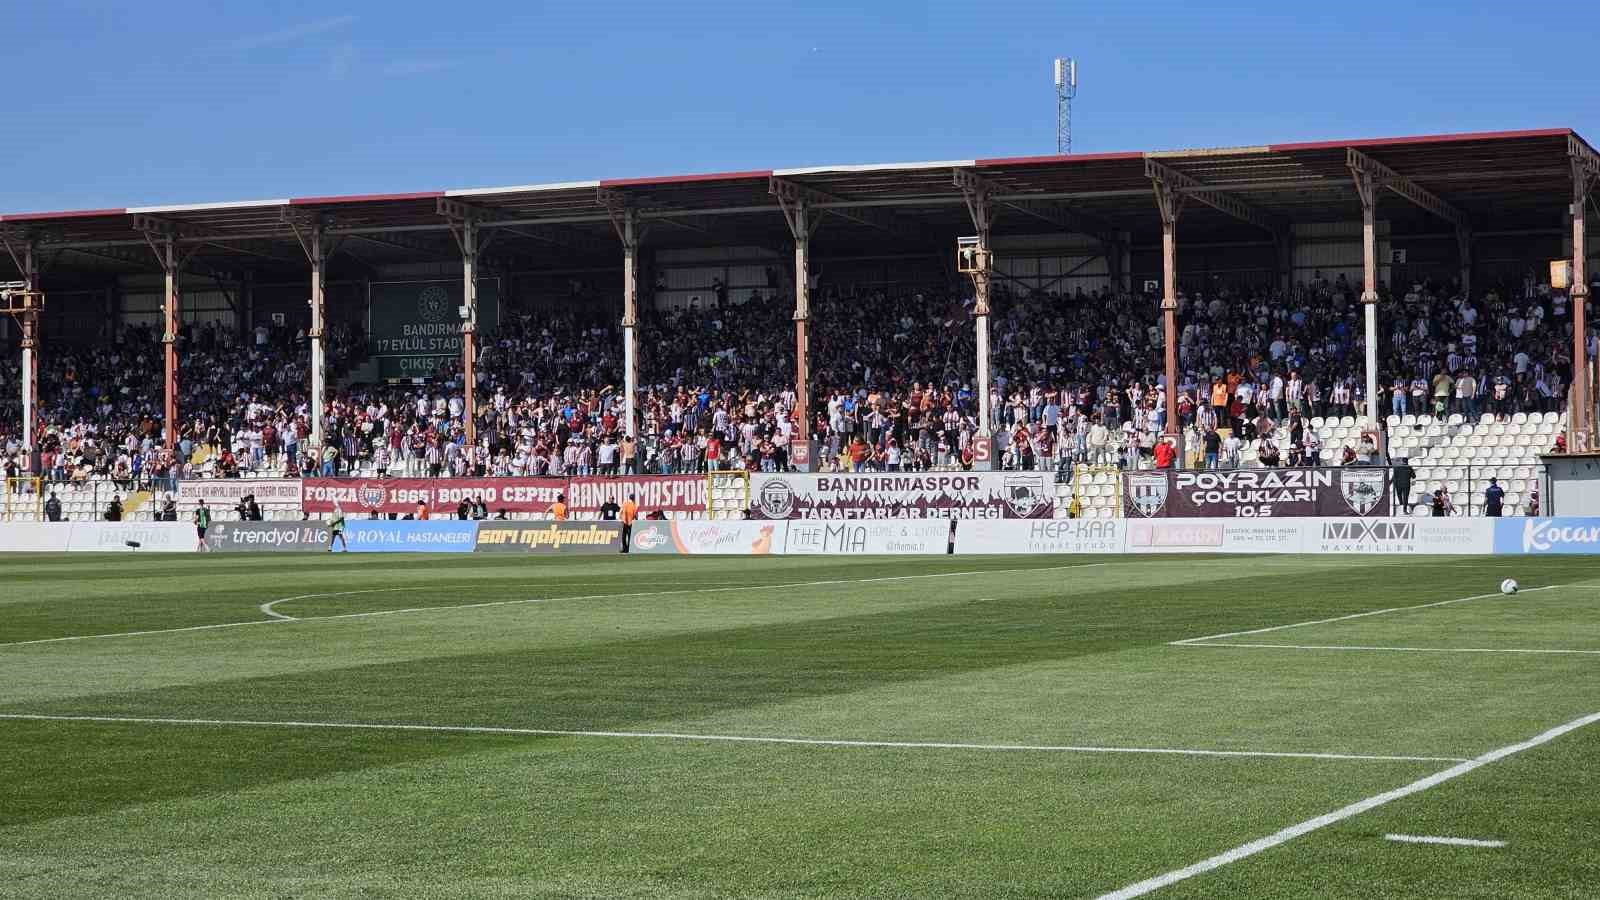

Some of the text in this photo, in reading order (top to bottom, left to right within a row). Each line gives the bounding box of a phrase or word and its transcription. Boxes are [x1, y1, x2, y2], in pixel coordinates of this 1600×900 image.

[377, 336, 465, 351] 17 EYLÜL STADY
[976, 440, 989, 460] S
[817, 477, 980, 491] BANDIRMASPOR
[1176, 470, 1332, 489] POYRAZIN
[304, 486, 358, 503] FORZA
[390, 489, 430, 503] 1965
[438, 487, 497, 503] BORDO
[569, 479, 709, 508] BANDIRMASPOR
[1191, 489, 1317, 506] ÇOCUKLARI
[798, 504, 1004, 520] TARAFTARLAR DERNEĞİ
[1235, 506, 1273, 517] 10,5
[232, 528, 300, 546] trendyol
[358, 530, 404, 543] ROYAL
[1030, 521, 1116, 539] HEP-KAR
